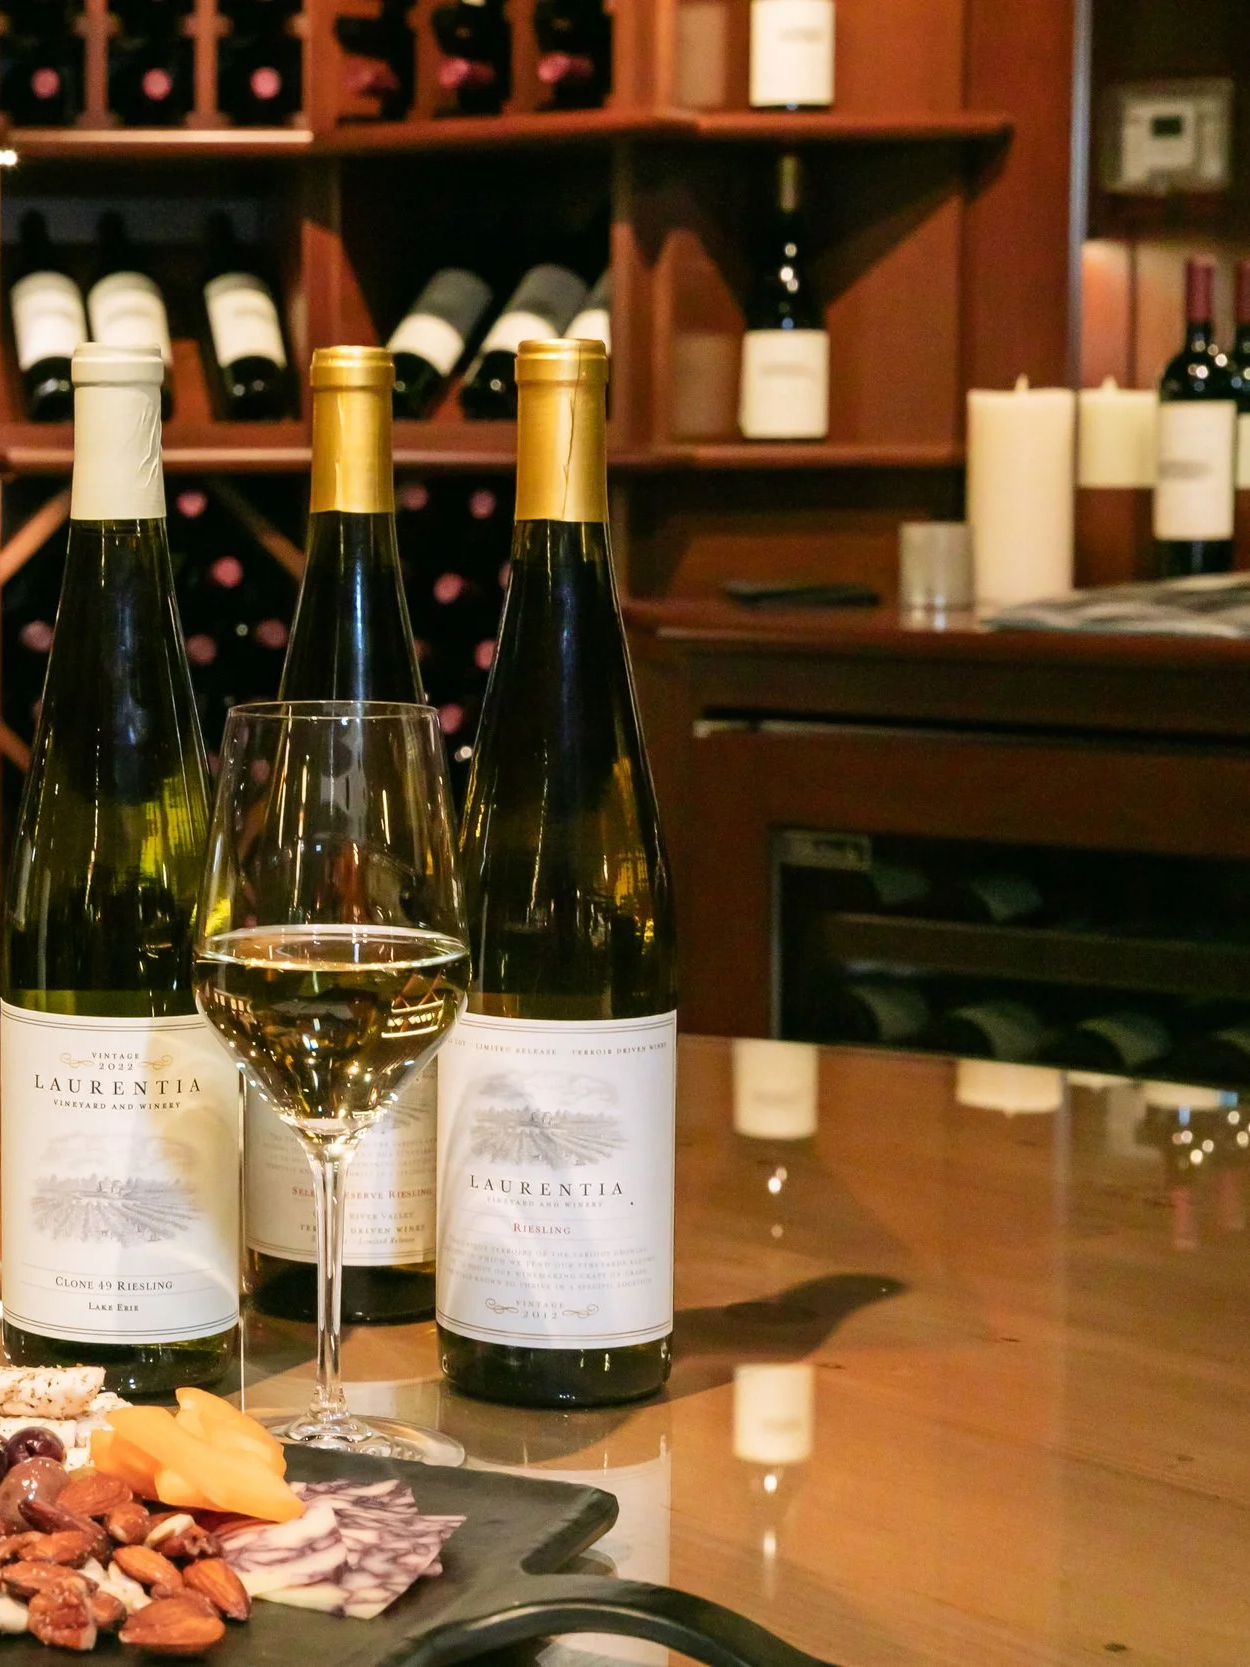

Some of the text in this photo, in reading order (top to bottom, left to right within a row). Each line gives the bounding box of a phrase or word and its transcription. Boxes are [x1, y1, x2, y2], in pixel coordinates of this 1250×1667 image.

[476, 1043, 511, 1053] LIMITED
[515, 1048, 557, 1056] RELEASE
[617, 1046, 646, 1055] DRIVEN
[92, 1052, 140, 1060] VINTAGE
[99, 1062, 134, 1071] 2022
[34, 1074, 201, 1096] LAURENTIA
[53, 1099, 106, 1110] VINEYARD
[139, 1101, 181, 1110] WINERY
[470, 1174, 624, 1197] LAURENTIA
[345, 1191, 384, 1200] ESERVE
[98, 1281, 112, 1291] 49
[516, 1300, 565, 1309] VINTAGE
[522, 1311, 558, 1320] 2012
